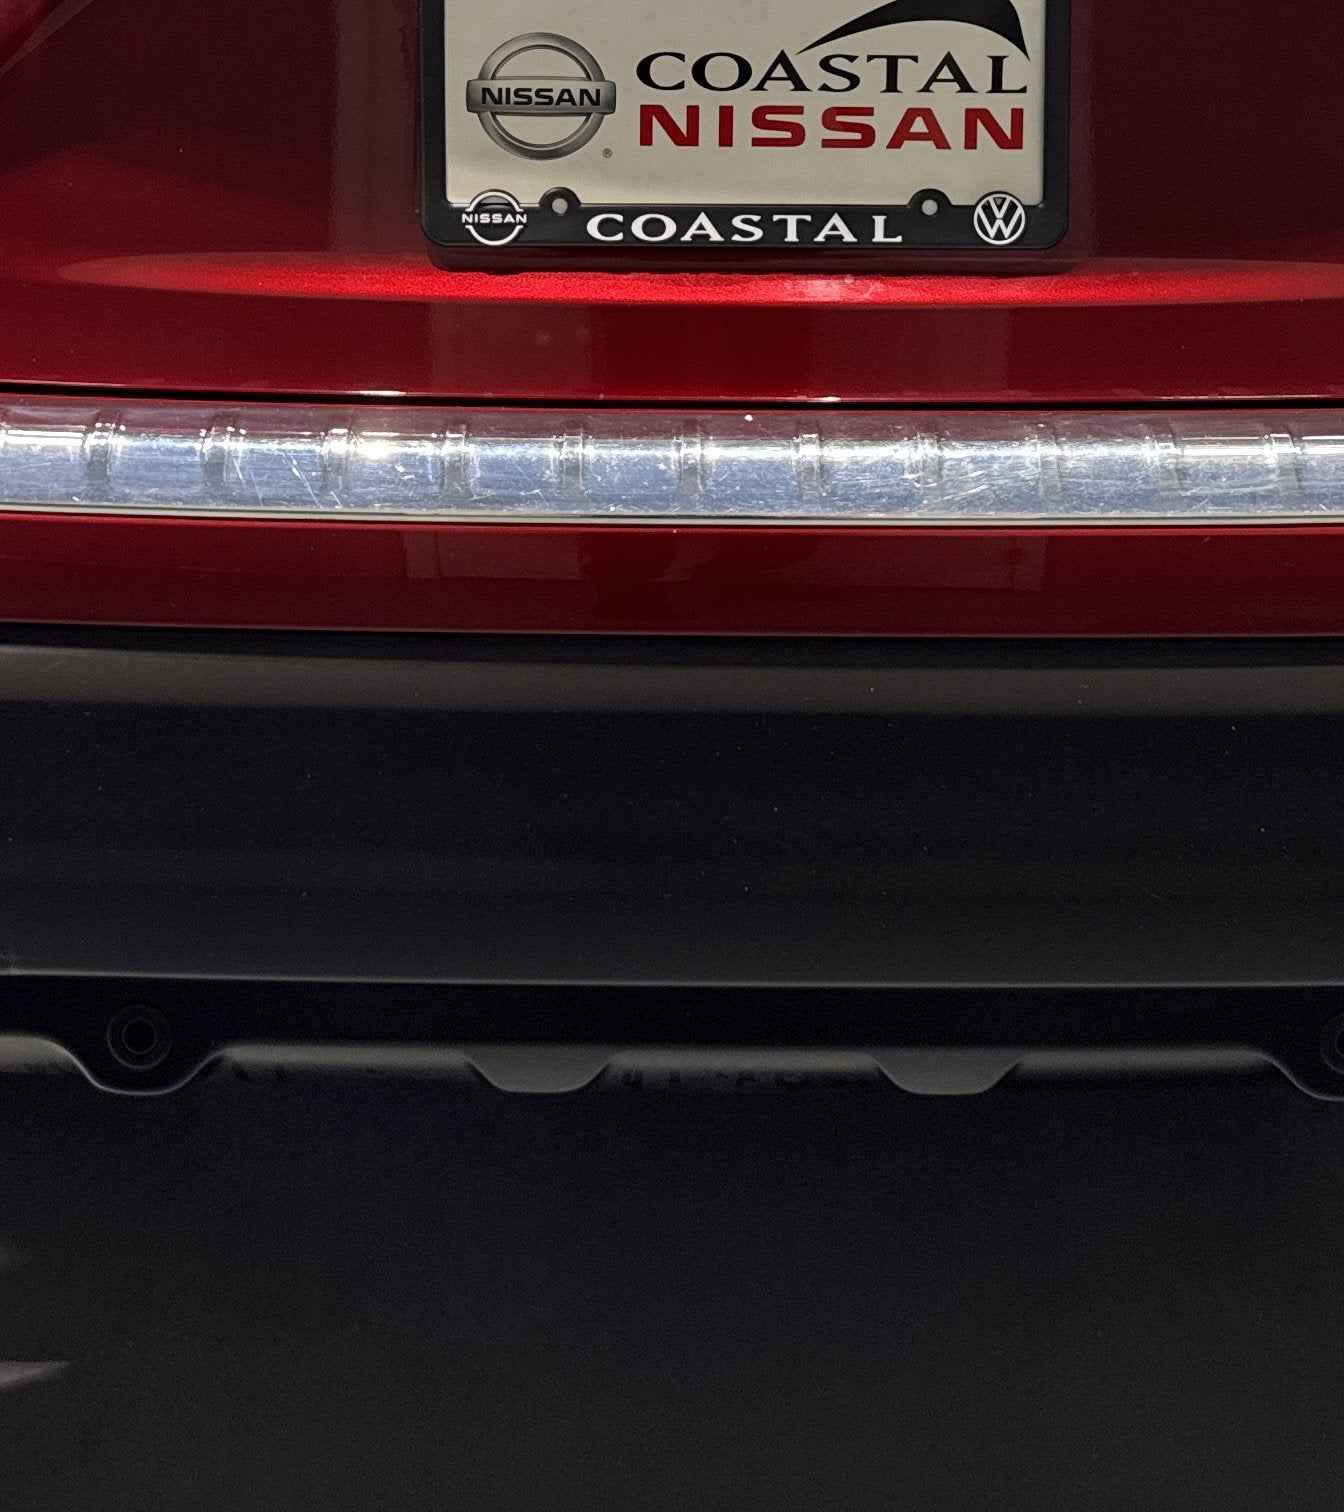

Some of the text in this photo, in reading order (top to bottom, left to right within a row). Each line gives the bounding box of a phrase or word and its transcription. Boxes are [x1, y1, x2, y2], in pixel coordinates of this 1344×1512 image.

[635, 49, 1029, 95] COASTAL
[480, 85, 602, 107] NISSAN
[639, 104, 1025, 151] NISSAN
[461, 213, 528, 224] NISSAN
[586, 211, 904, 243] COASTAL
